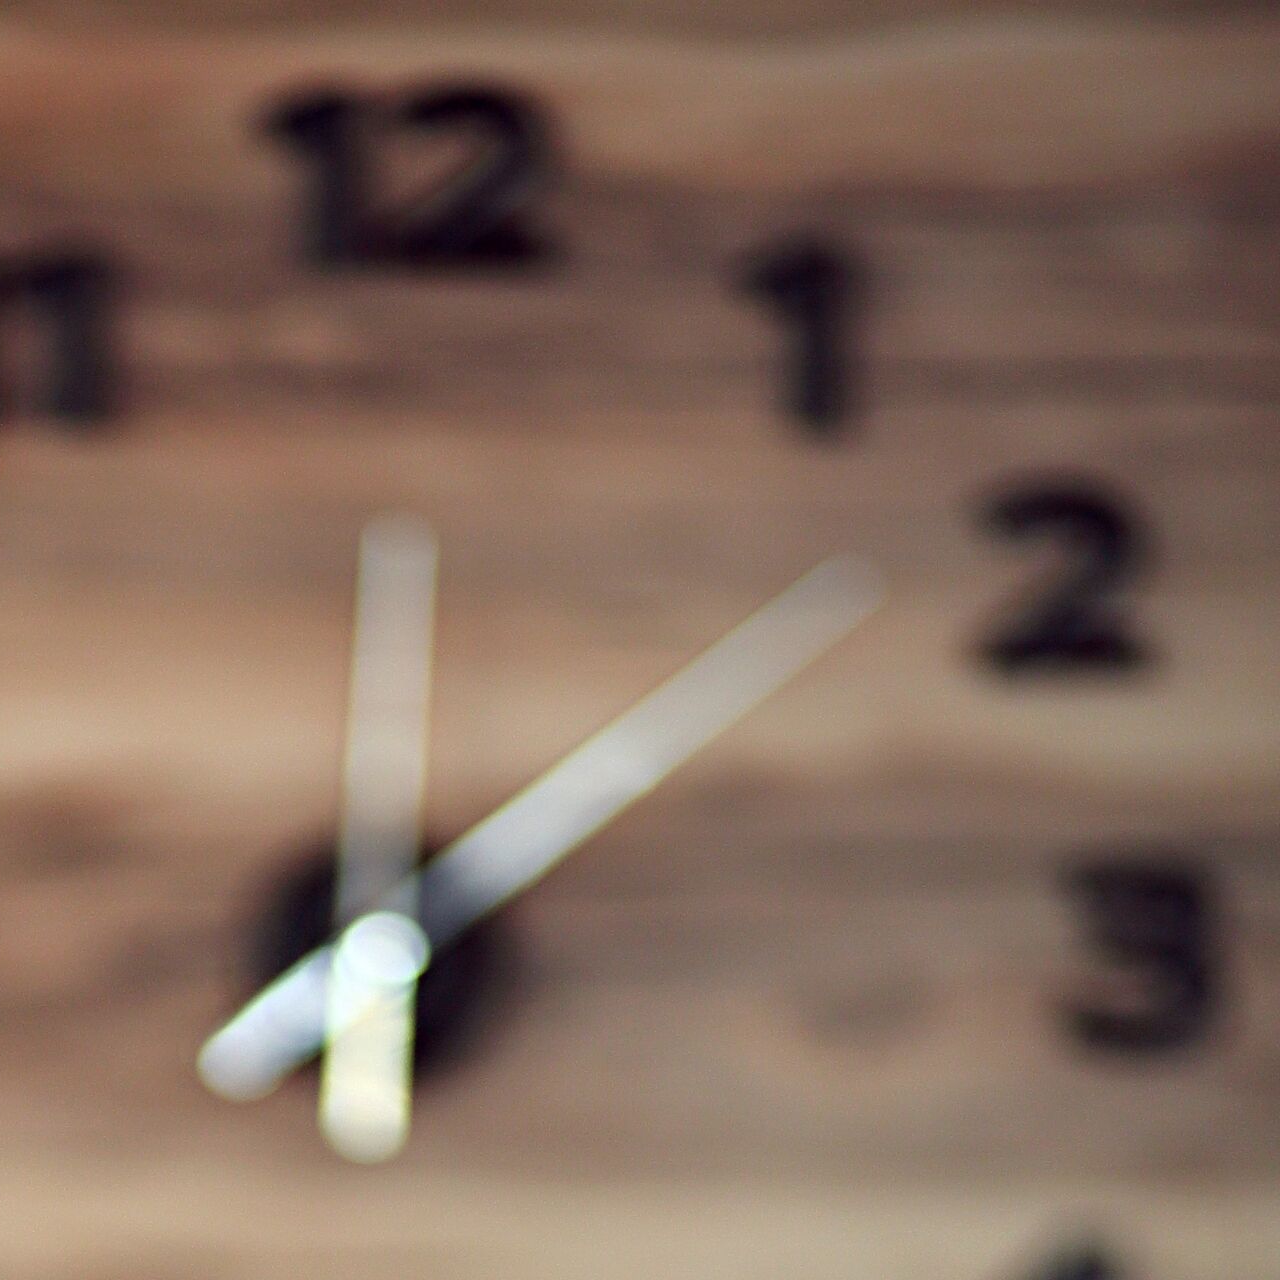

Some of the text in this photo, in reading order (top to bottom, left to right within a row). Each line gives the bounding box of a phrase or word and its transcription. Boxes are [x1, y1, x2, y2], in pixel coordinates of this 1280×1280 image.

[260, 84, 558, 270] 12
[740, 236, 866, 436] 1
[978, 478, 1156, 674] 2
[1062, 852, 1224, 1054] 3
